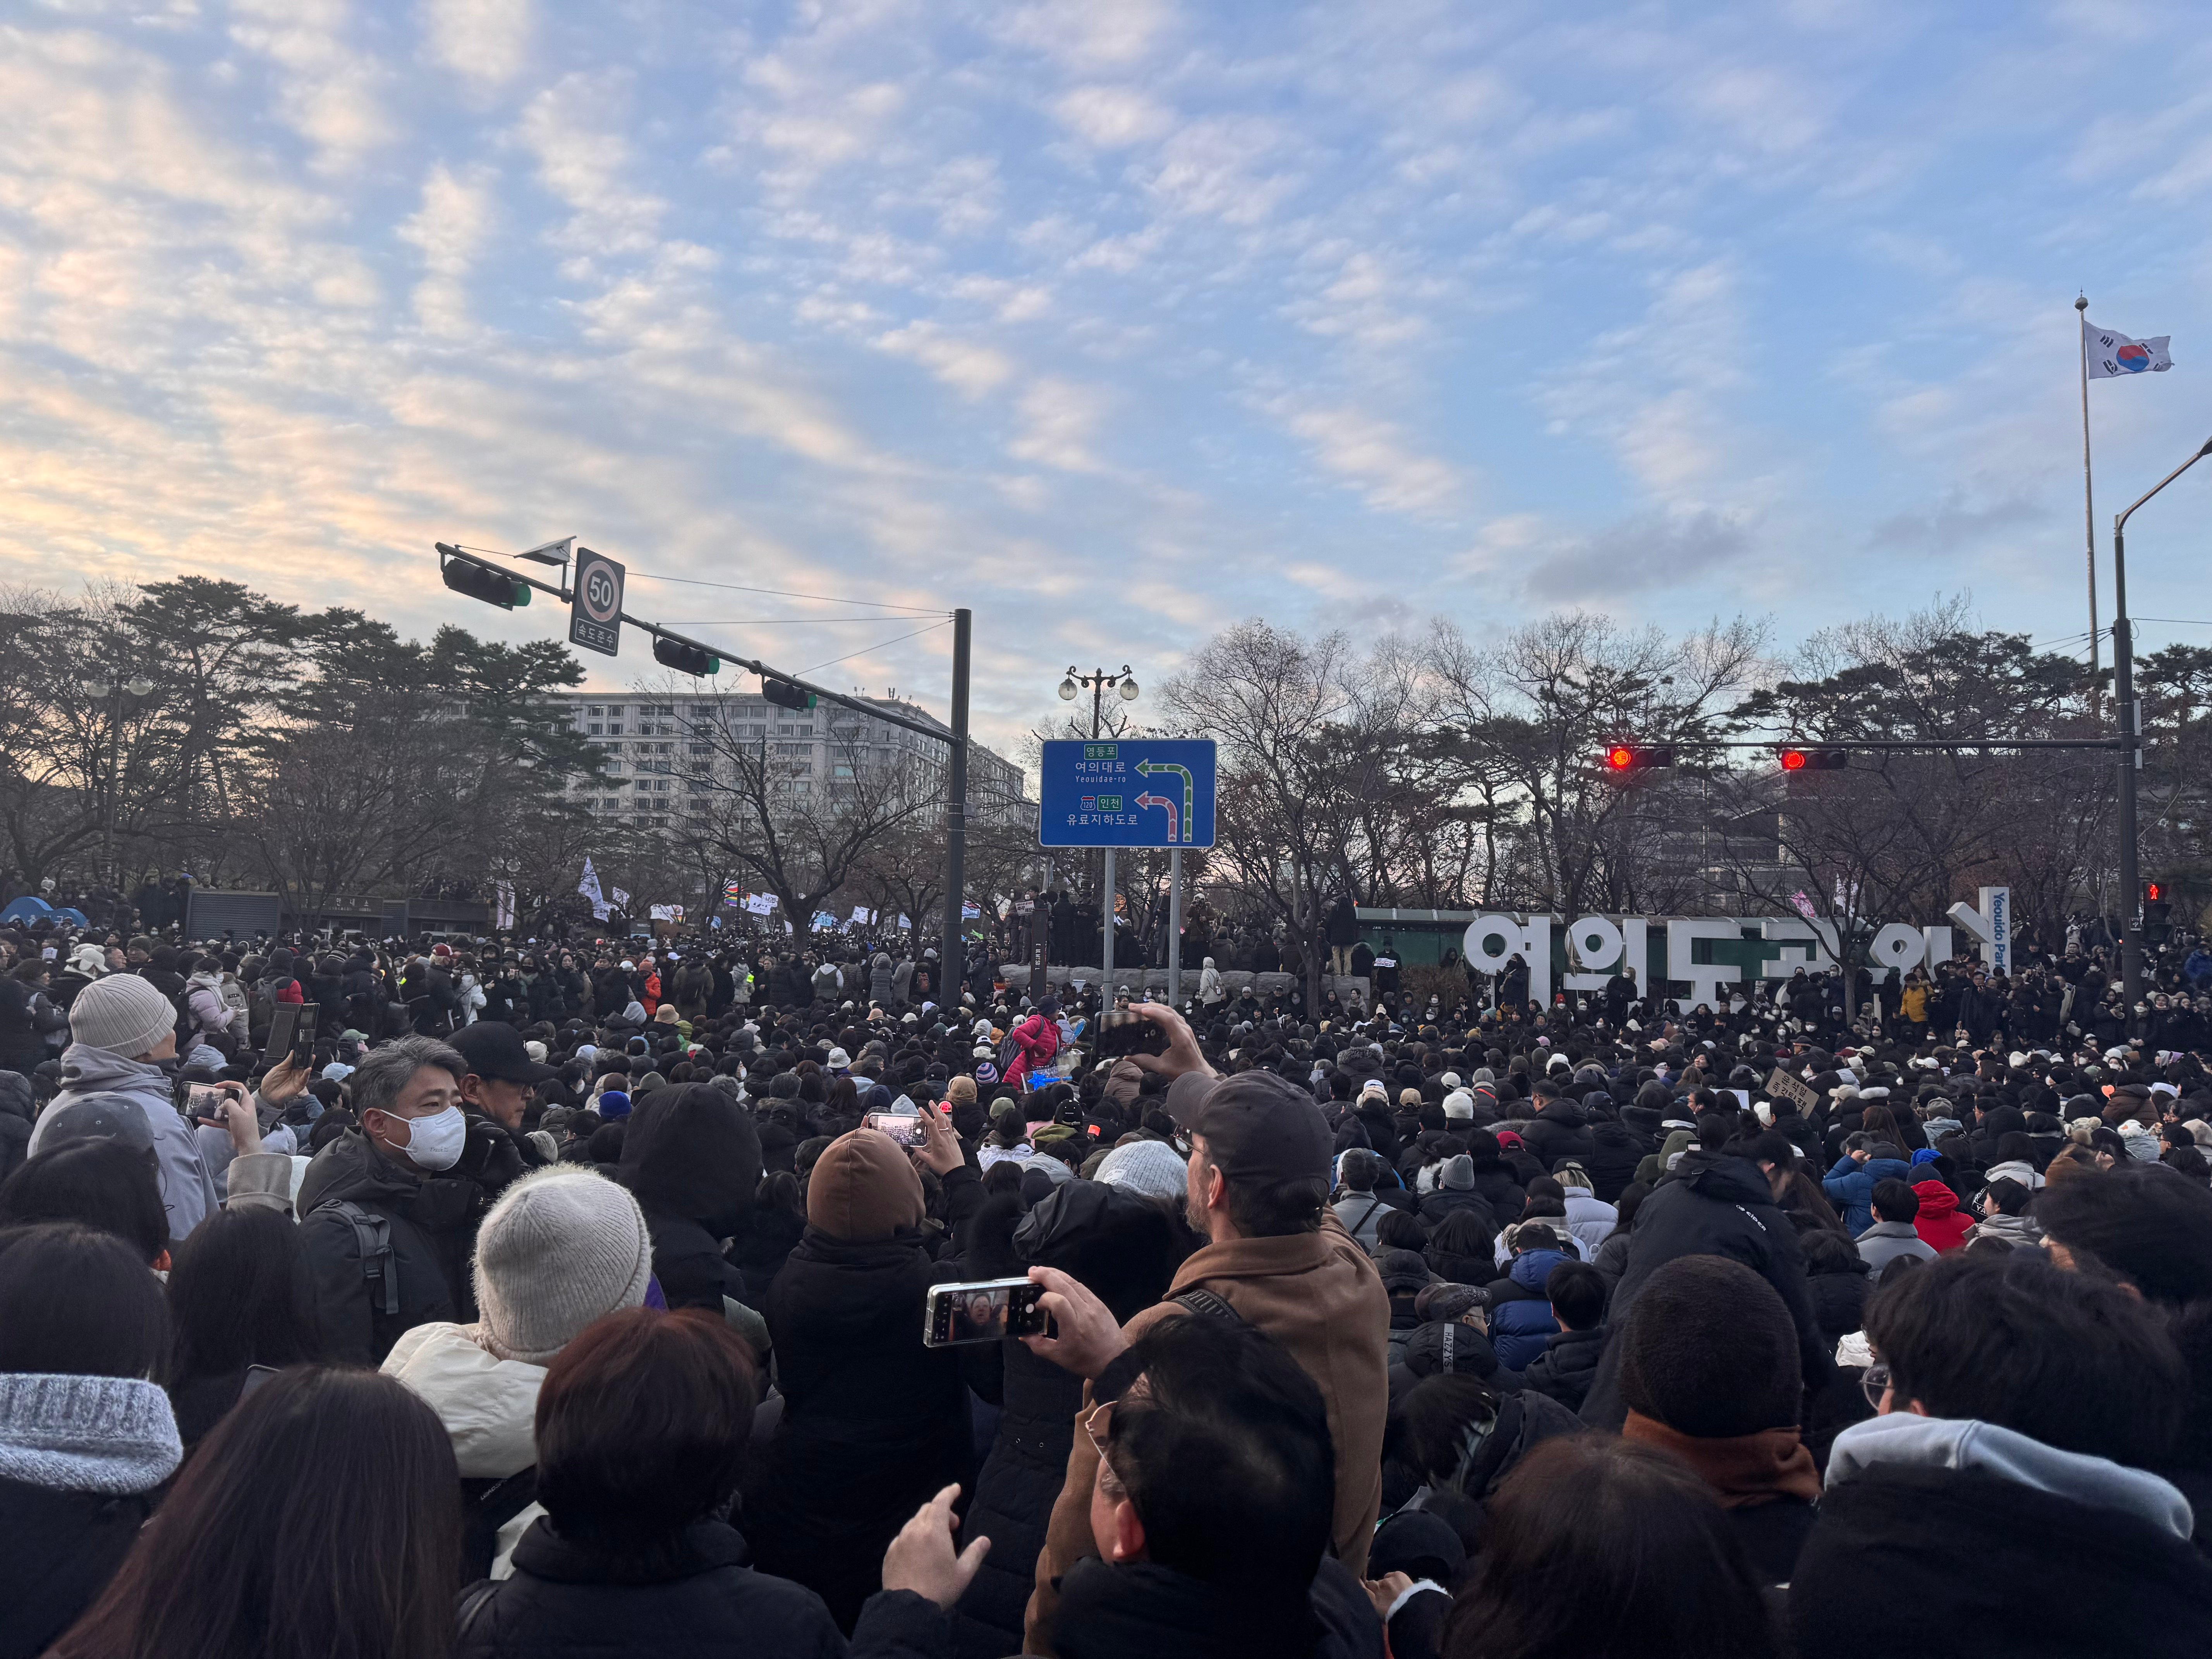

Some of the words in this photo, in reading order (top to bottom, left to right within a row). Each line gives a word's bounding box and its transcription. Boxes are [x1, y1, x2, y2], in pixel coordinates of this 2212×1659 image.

[589, 576, 611, 606] 50
[578, 624, 614, 646] 속도준수
[1086, 747, 1116, 757] 영등포
[1075, 762, 1126, 773] 여의대로
[1101, 799, 1120, 809] 인천
[1066, 814, 1138, 826] 유료지하도로
[1994, 892, 2005, 940] Yeouido
[1444, 1332, 1453, 1367] HAZZYS
